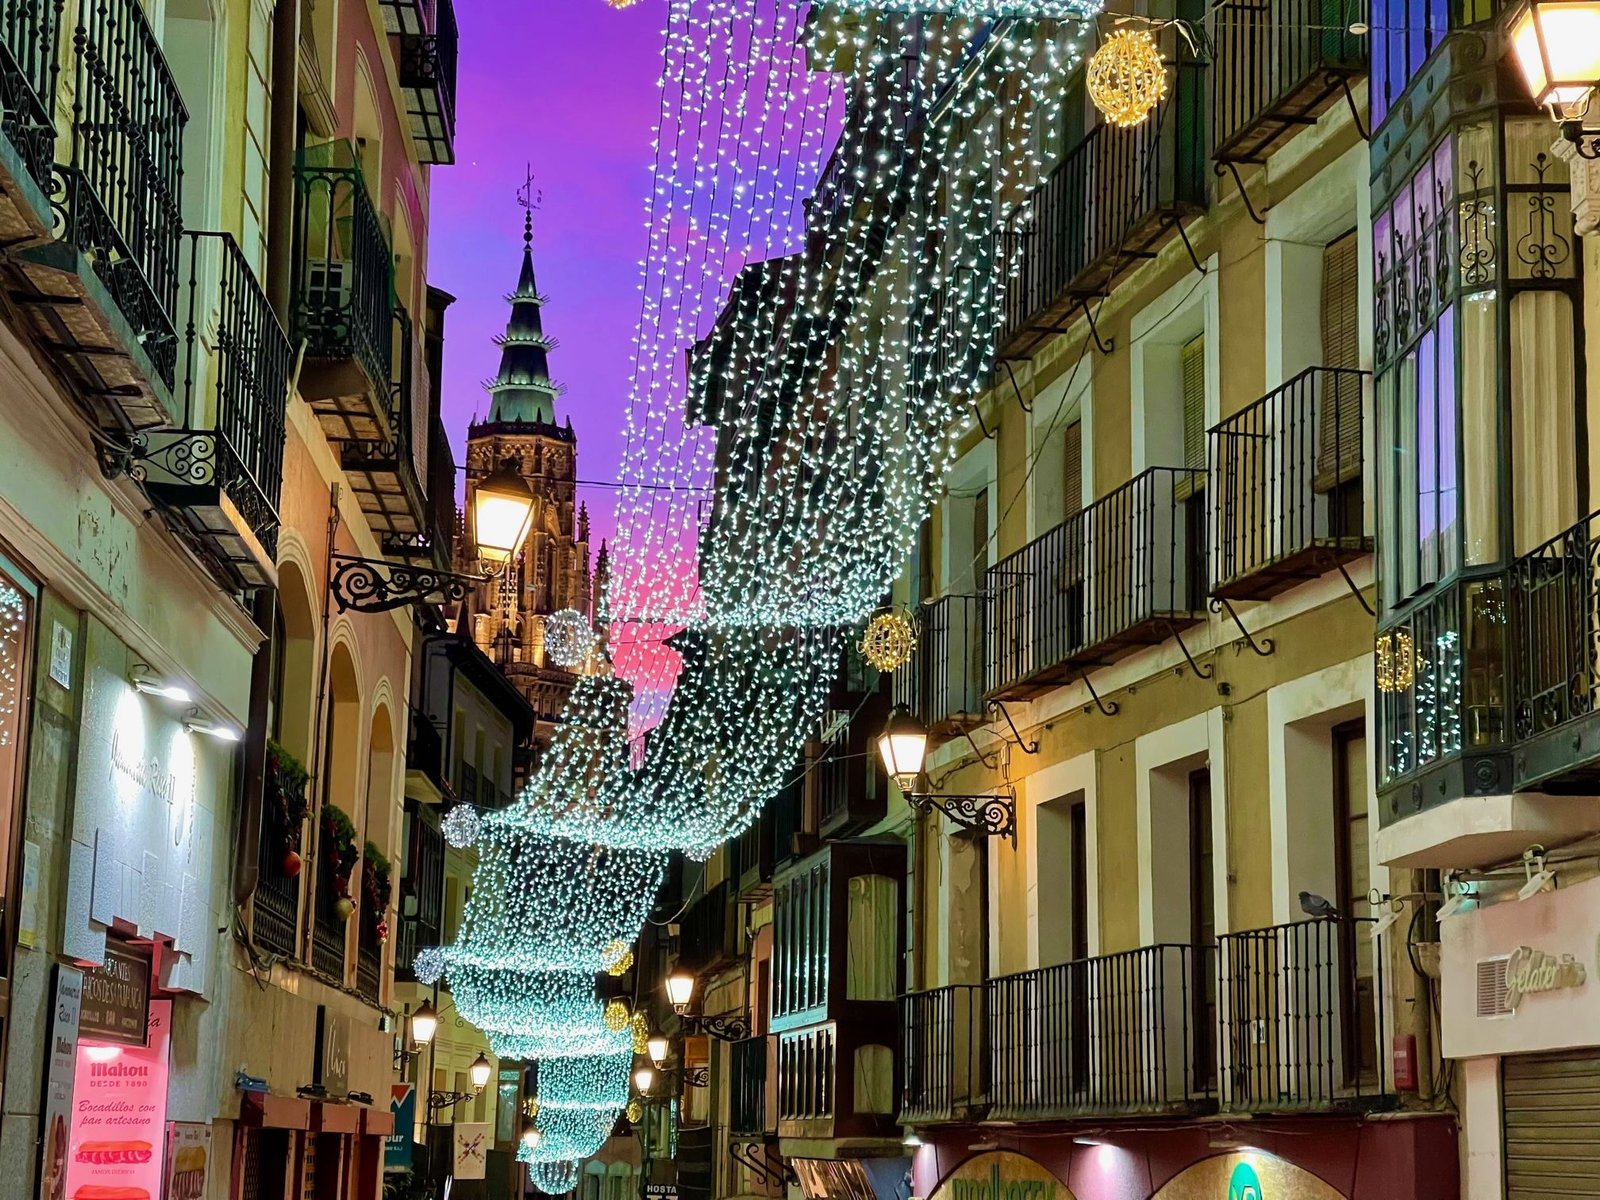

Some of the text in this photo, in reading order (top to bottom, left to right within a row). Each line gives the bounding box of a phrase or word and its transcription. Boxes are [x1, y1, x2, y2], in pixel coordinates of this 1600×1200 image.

[91, 1063, 148, 1077] Mahou
[78, 1100, 156, 1112] Bocadillos con
[80, 1116, 151, 1127] pan artesano
[646, 1184, 677, 1194] HOSTA
